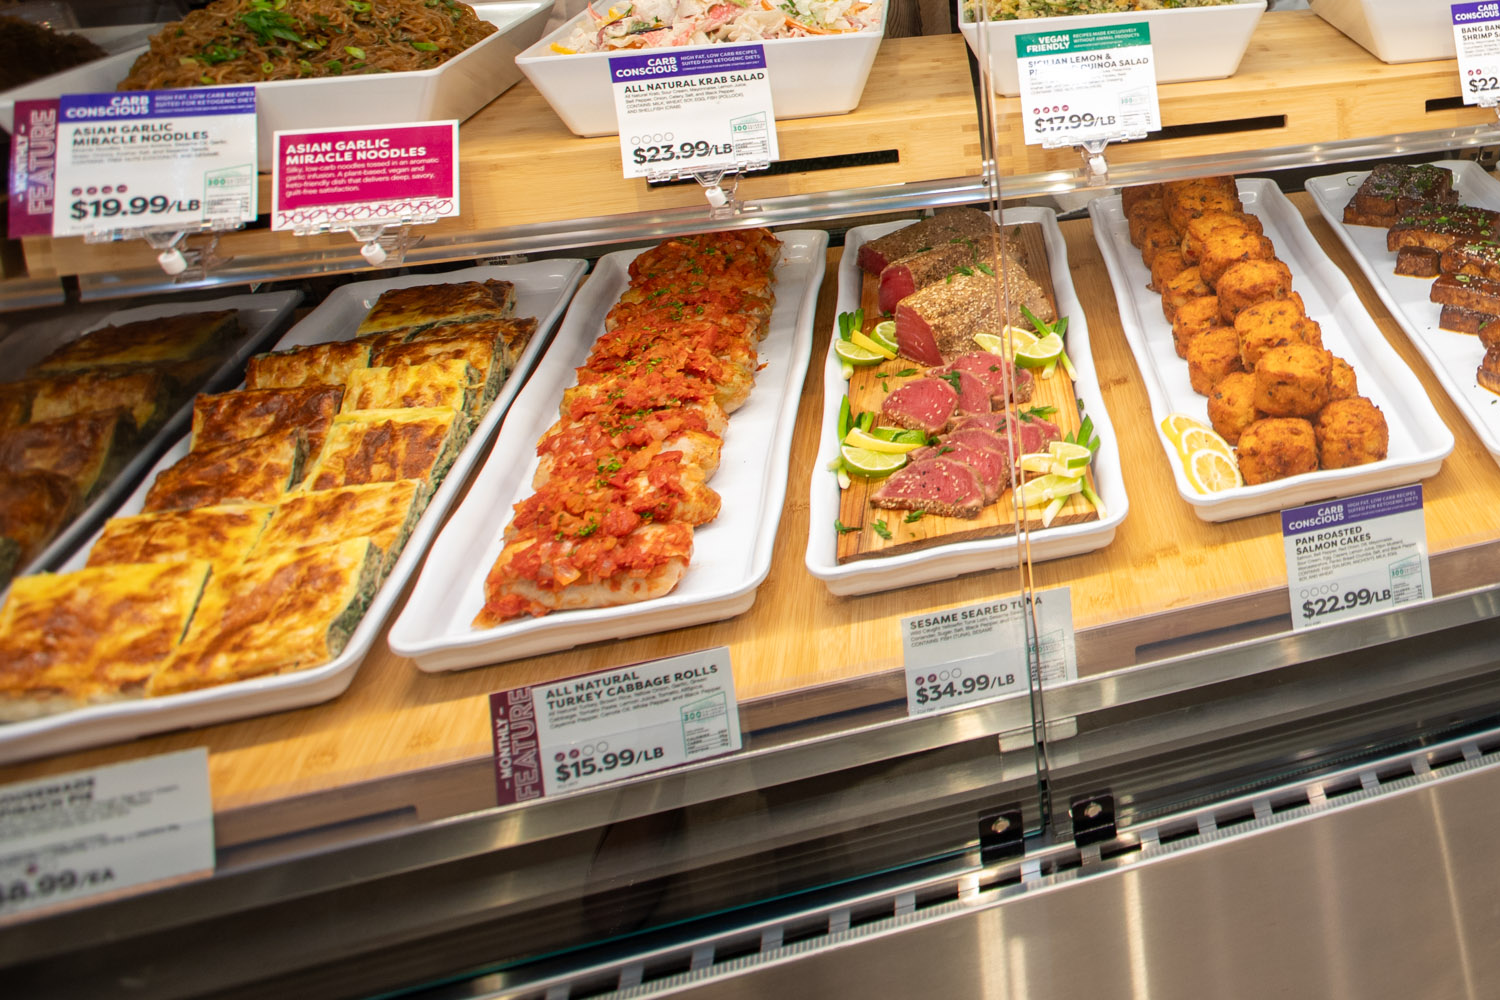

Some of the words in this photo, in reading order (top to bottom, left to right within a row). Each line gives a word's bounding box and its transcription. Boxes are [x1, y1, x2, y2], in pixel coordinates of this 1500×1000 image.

[1455, 10, 1500, 21] CONSCIOUS
[1461, 25, 1483, 34] BANG
[1462, 33, 1493, 41] SHRIMP
[1026, 42, 1070, 53] FRIENDLY
[1038, 34, 1070, 44] VEGAN
[647, 57, 677, 66] CARB
[713, 55, 744, 63] KETOGENIC
[1070, 54, 1103, 64] LEMON
[1119, 58, 1149, 68] SALAD
[616, 65, 678, 78] CONSCIOUS
[647, 80, 696, 91] NATURAL
[700, 77, 728, 86] KRAB
[730, 72, 765, 82] SALAD
[111, 96, 150, 107] CARB
[66, 106, 150, 118] CONSCIOUS
[73, 125, 117, 137] ASIAN
[121, 123, 173, 134] GARLIC
[72, 135, 137, 147] MIRACLE
[141, 131, 209, 142] NOODLES
[286, 142, 332, 155] ASIAN
[335, 138, 390, 151] GARLIC
[286, 152, 353, 165] MIRACLE
[356, 147, 427, 160] NOODLES
[633, 140, 733, 165] $23.99/LB
[28, 108, 56, 215] FEATURE
[70, 195, 200, 221] $19.99/LB
[1318, 504, 1344, 517] CARB
[1289, 513, 1344, 530] CONSCIOUS
[1296, 536, 1315, 546] PAN
[1317, 526, 1363, 542] ROASTED
[1296, 540, 1338, 555] SALMON
[1340, 533, 1371, 546] CAKES
[1302, 588, 1391, 619] $22.99/LB
[910, 613, 958, 630] SESAME
[961, 604, 1008, 620] SEARED
[546, 687, 572, 699] ALL
[575, 671, 640, 692] NATURAL
[547, 691, 603, 710] TURKEY
[607, 675, 671, 698] CABBAGE
[674, 664, 718, 682] ROLLS
[916, 673, 1015, 705] $34.99/LB
[496, 718, 513, 780] MONTHLY
[507, 686, 540, 802] FEATURE
[555, 747, 664, 783] $15.99/LB
